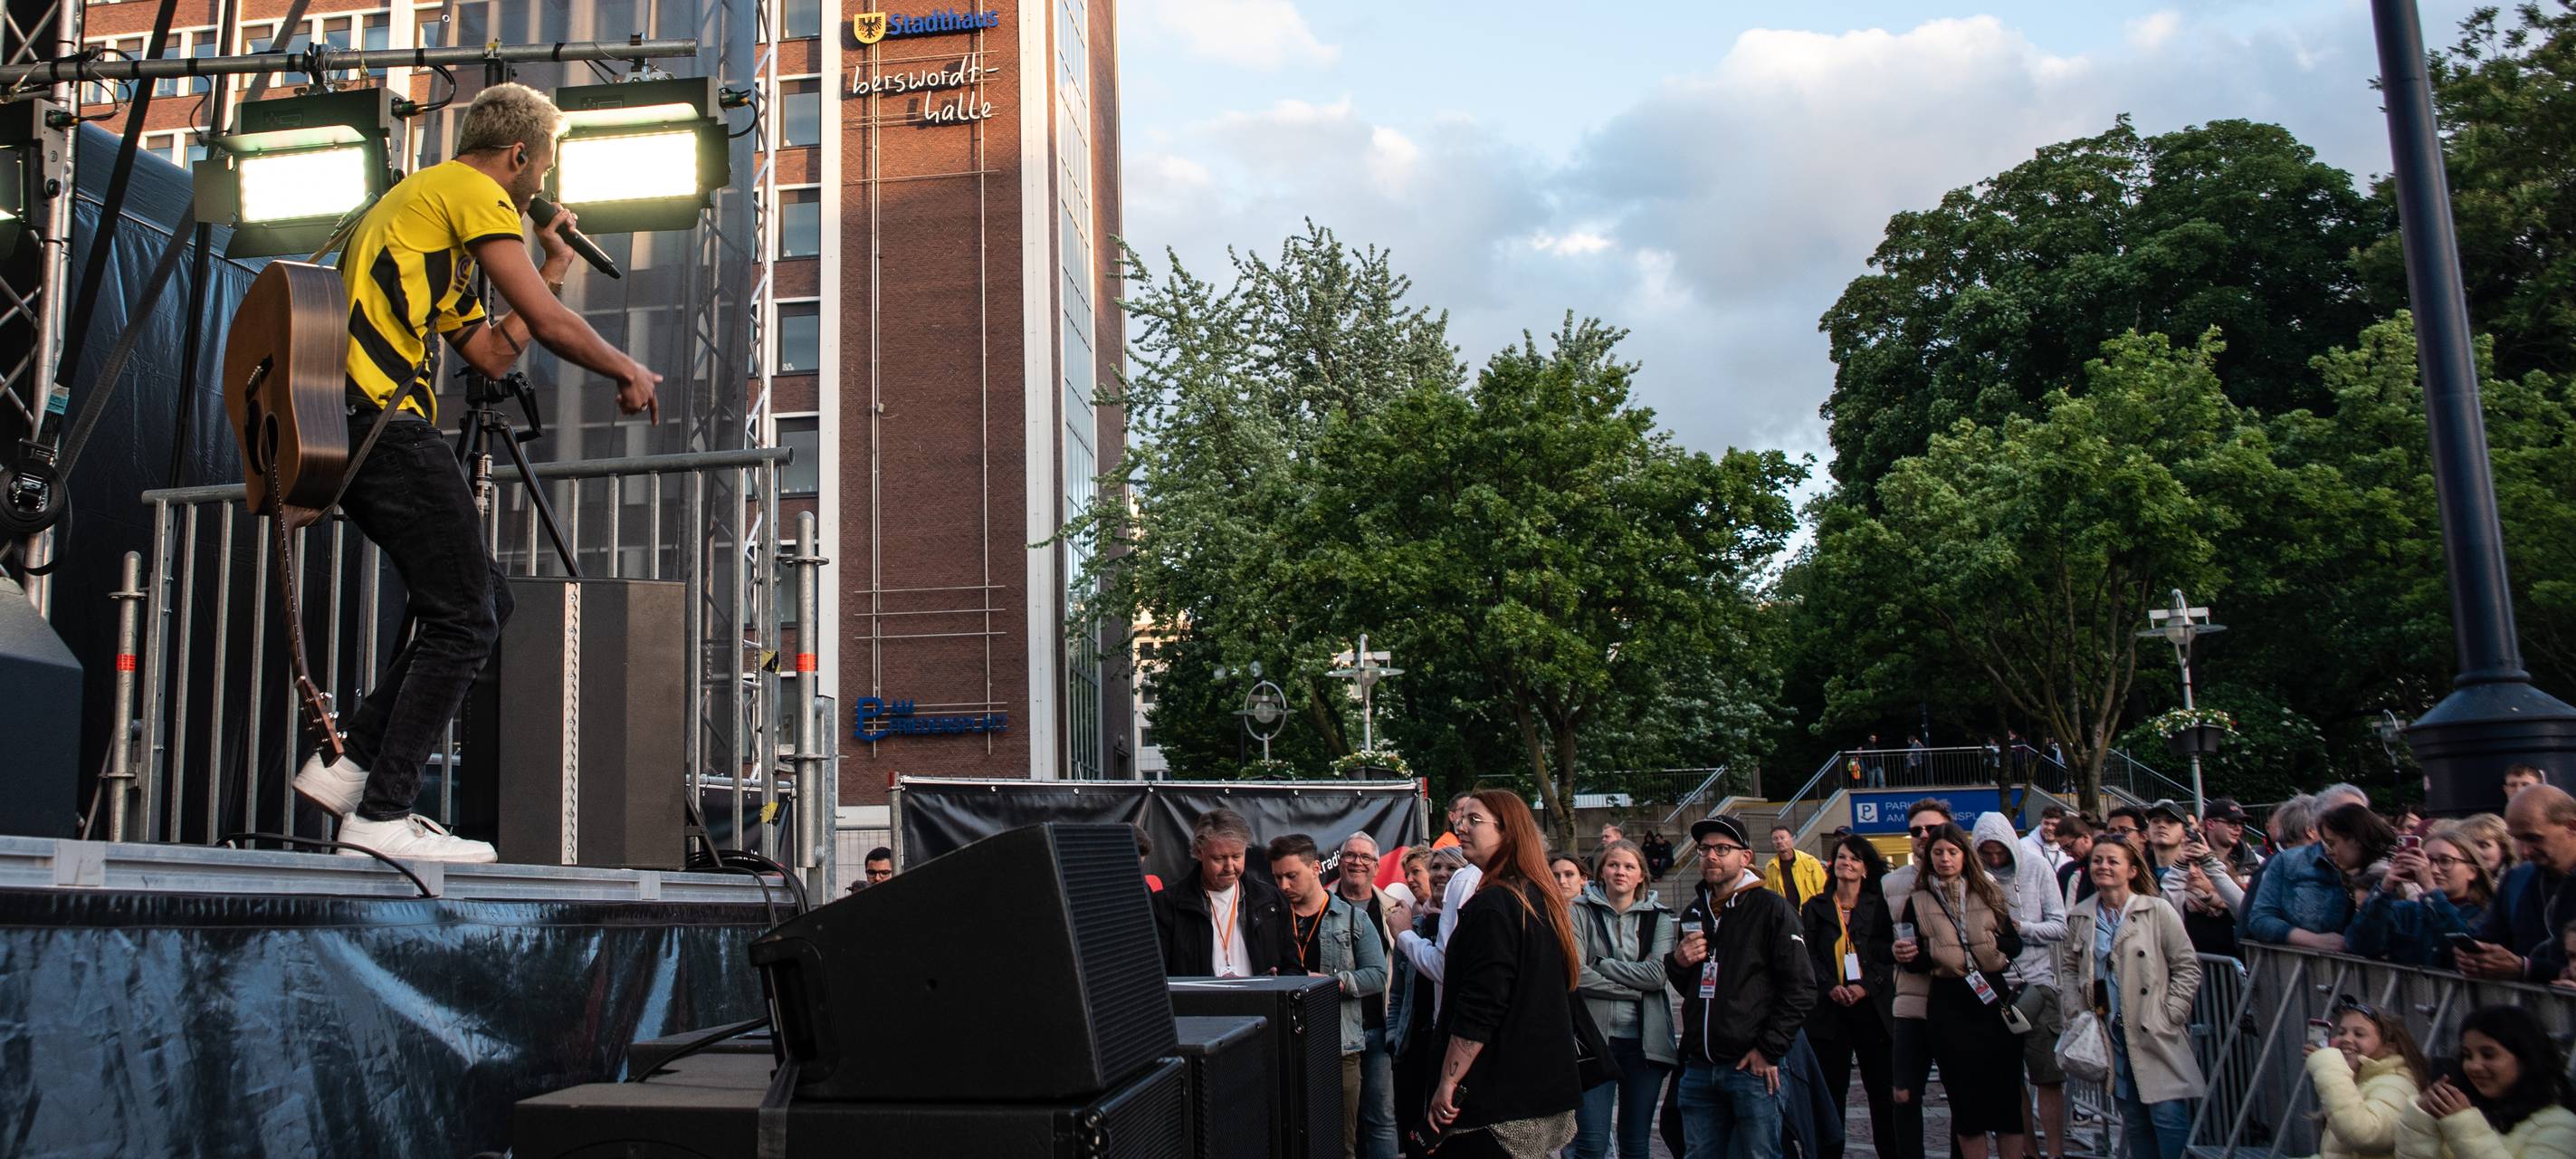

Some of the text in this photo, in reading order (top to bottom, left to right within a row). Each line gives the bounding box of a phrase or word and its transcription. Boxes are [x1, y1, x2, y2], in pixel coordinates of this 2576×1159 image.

[889, 8, 999, 35] Stadthaus
[852, 53, 1000, 95] berswordt-
[923, 91, 993, 123] halle
[890, 698, 915, 714] AM
[1885, 813, 1905, 822] AM
